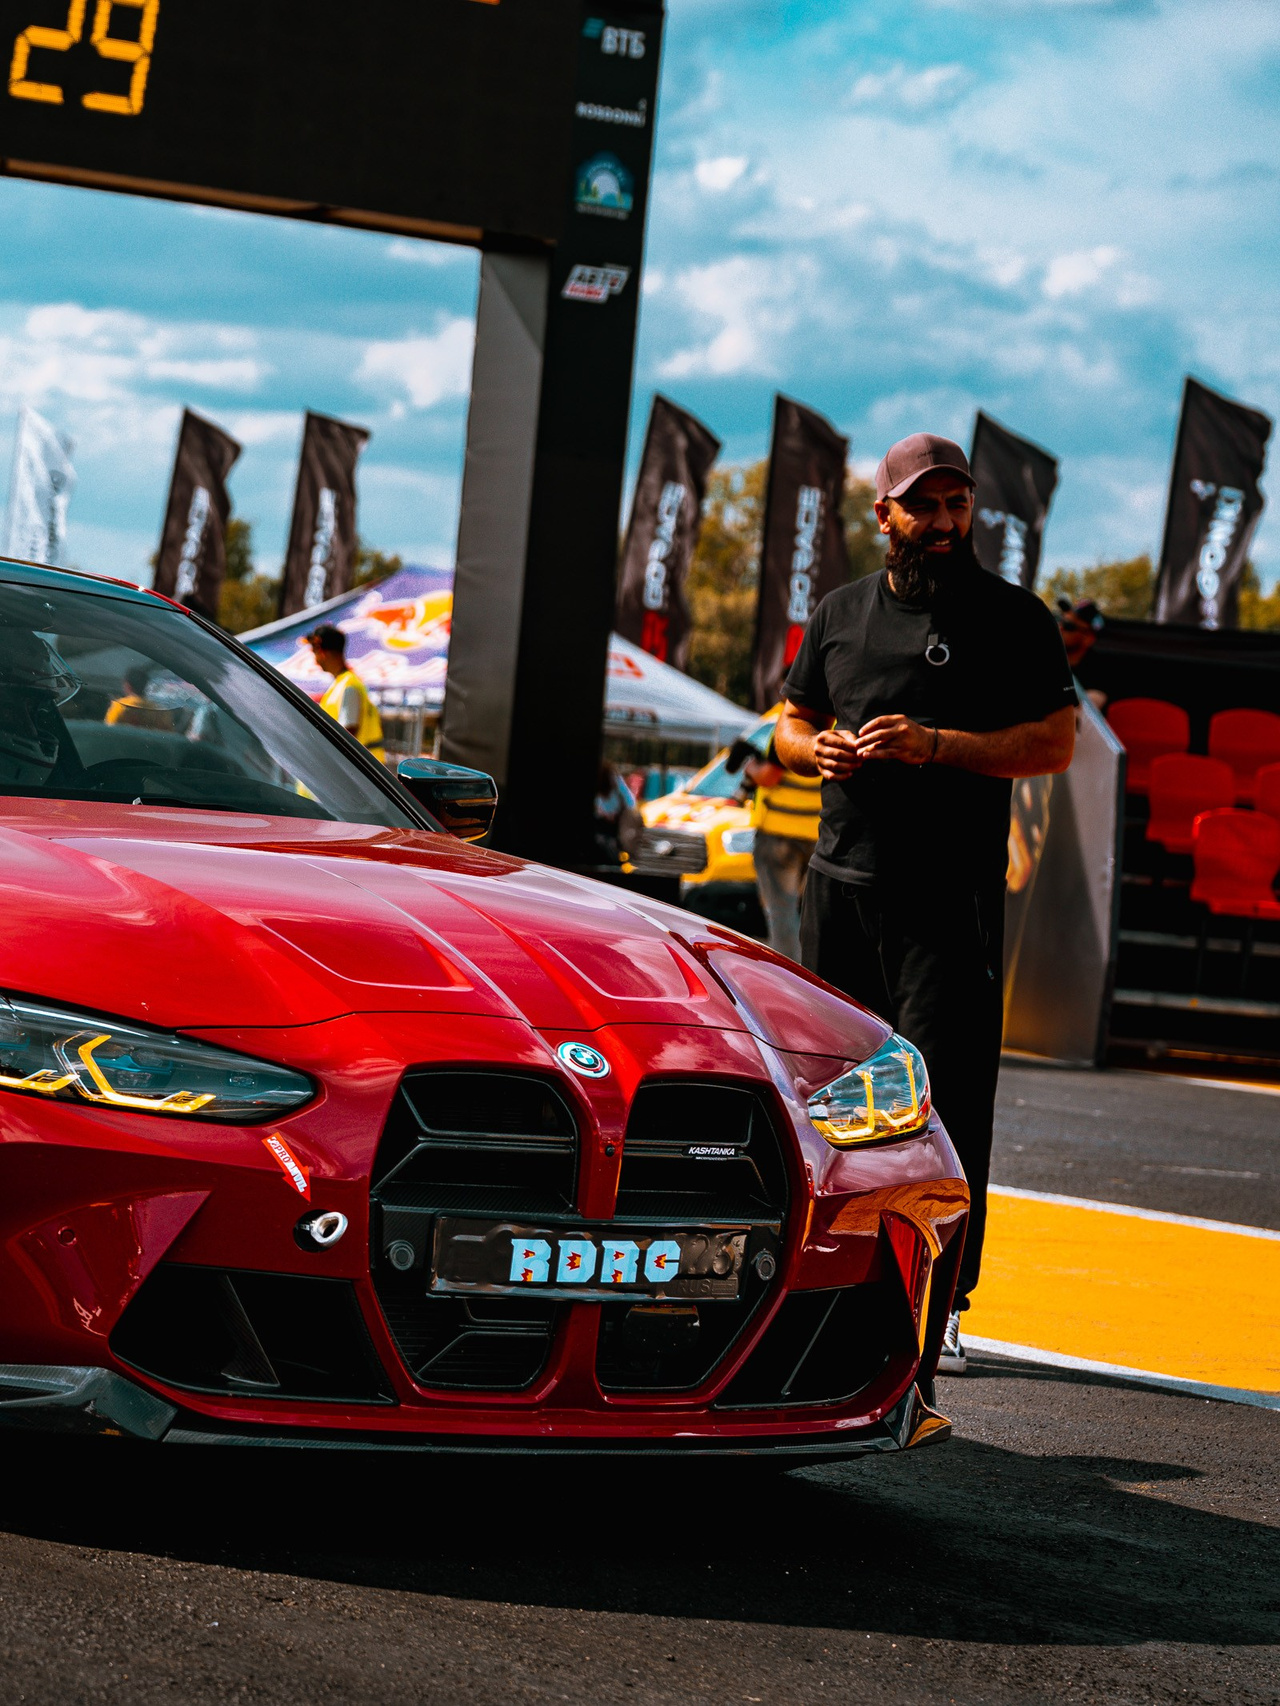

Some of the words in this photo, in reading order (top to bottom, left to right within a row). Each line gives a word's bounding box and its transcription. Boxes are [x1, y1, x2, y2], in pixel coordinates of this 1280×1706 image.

[601, 26, 645, 59] ВТБ
[688, 1146, 736, 1156] KASHTANKA
[509, 1238, 681, 1283] RDRC
